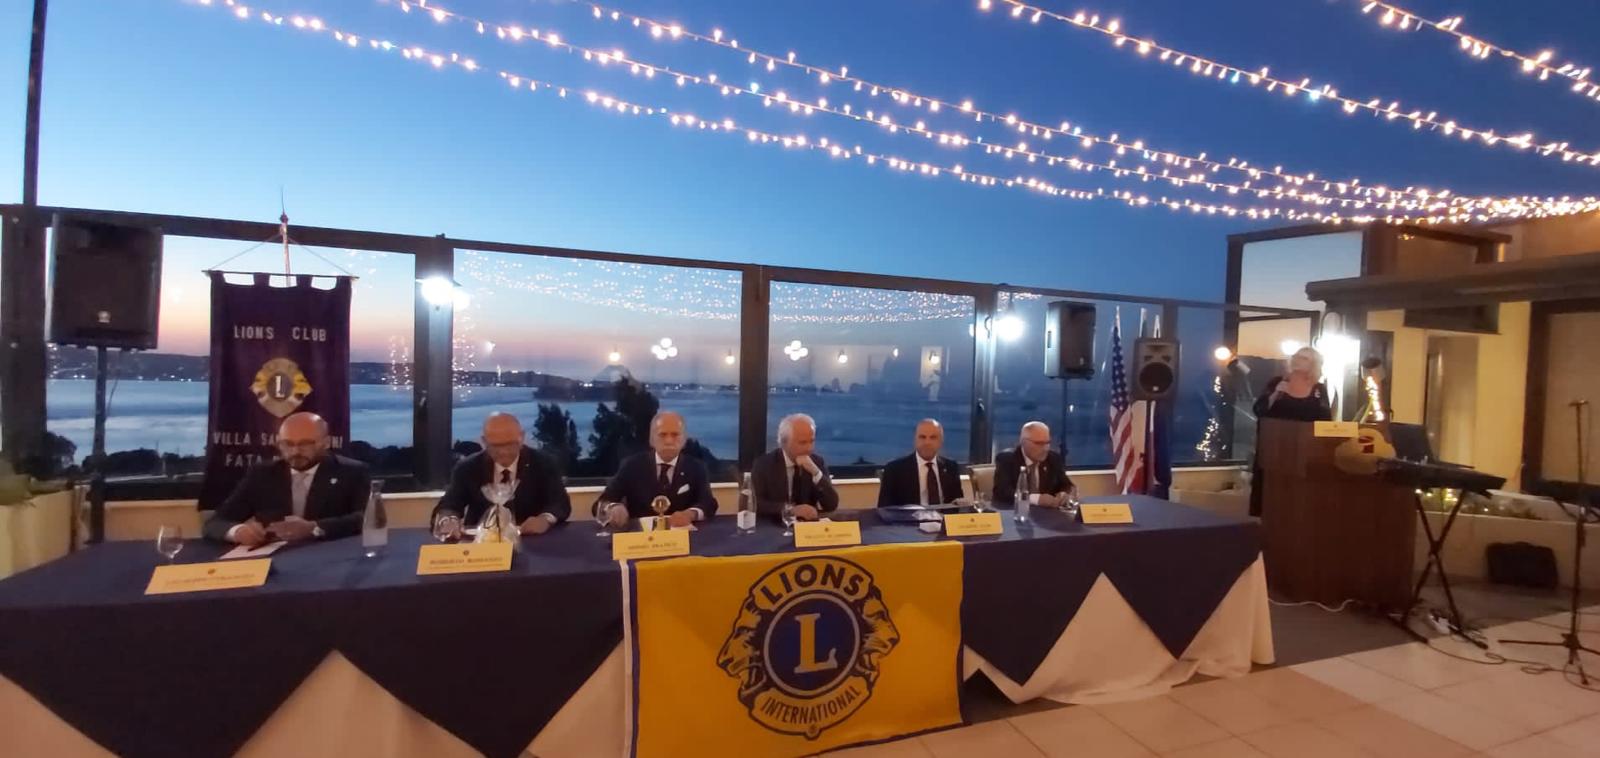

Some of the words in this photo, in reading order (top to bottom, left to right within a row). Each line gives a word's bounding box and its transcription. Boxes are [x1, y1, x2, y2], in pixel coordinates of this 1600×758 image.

[233, 325, 275, 340] LIONS
[292, 327, 327, 342] CLUB
[274, 375, 285, 399] L
[213, 432, 252, 446] VILLA
[225, 454, 262, 467] FATA
[760, 563, 864, 605] LIONS
[793, 613, 838, 674] L
[760, 685, 862, 725] INTERNATIONAL
